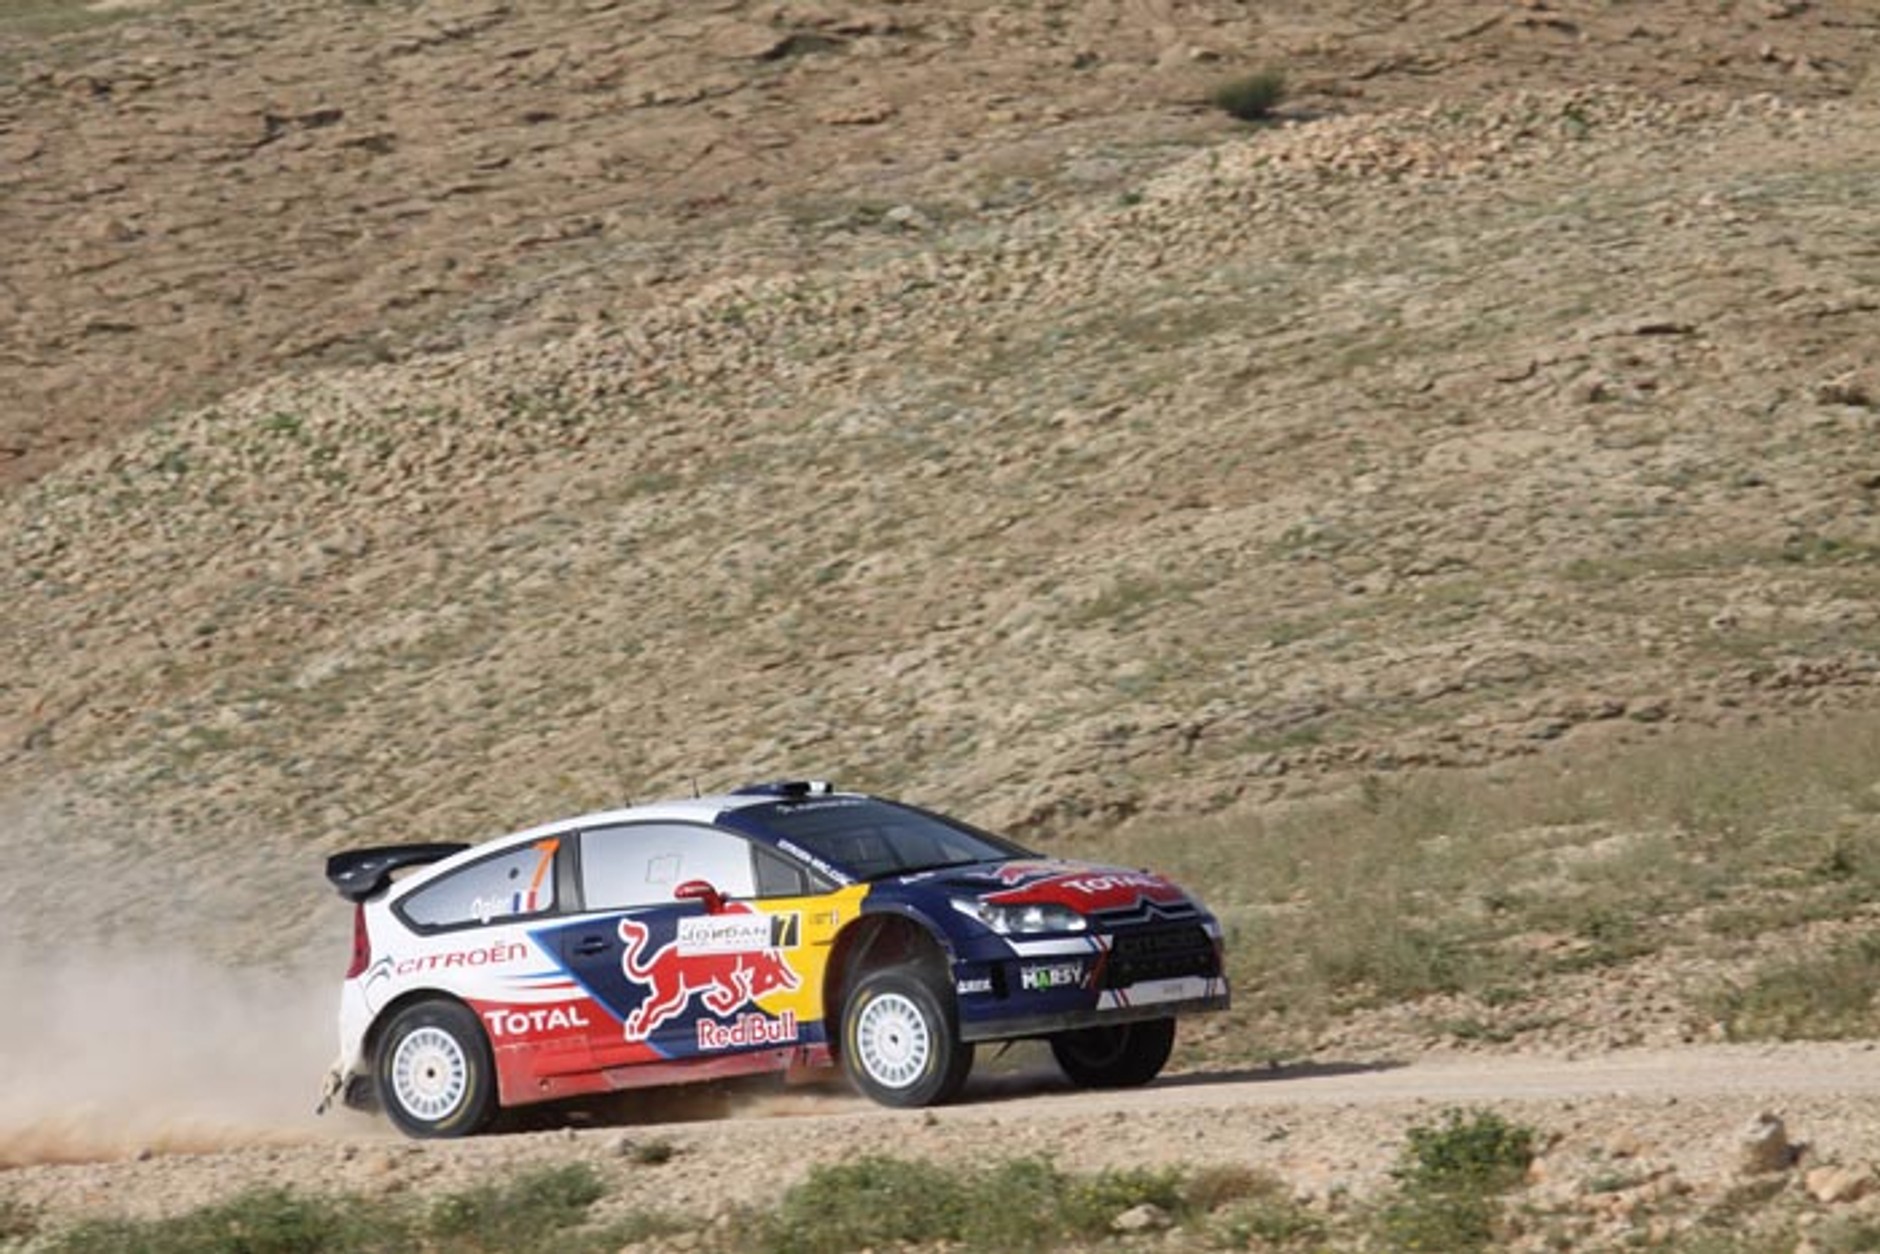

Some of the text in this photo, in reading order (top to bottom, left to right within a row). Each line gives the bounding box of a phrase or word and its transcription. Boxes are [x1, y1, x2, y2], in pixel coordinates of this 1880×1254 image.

[532, 838, 560, 890] 7
[1063, 874, 1165, 893] TOTAL
[777, 913, 793, 946] 7
[397, 941, 528, 976] CITROËN
[1021, 966, 1083, 990] MARSY
[485, 1006, 589, 1036] TOTAL
[698, 1011, 798, 1048] Red Bull
